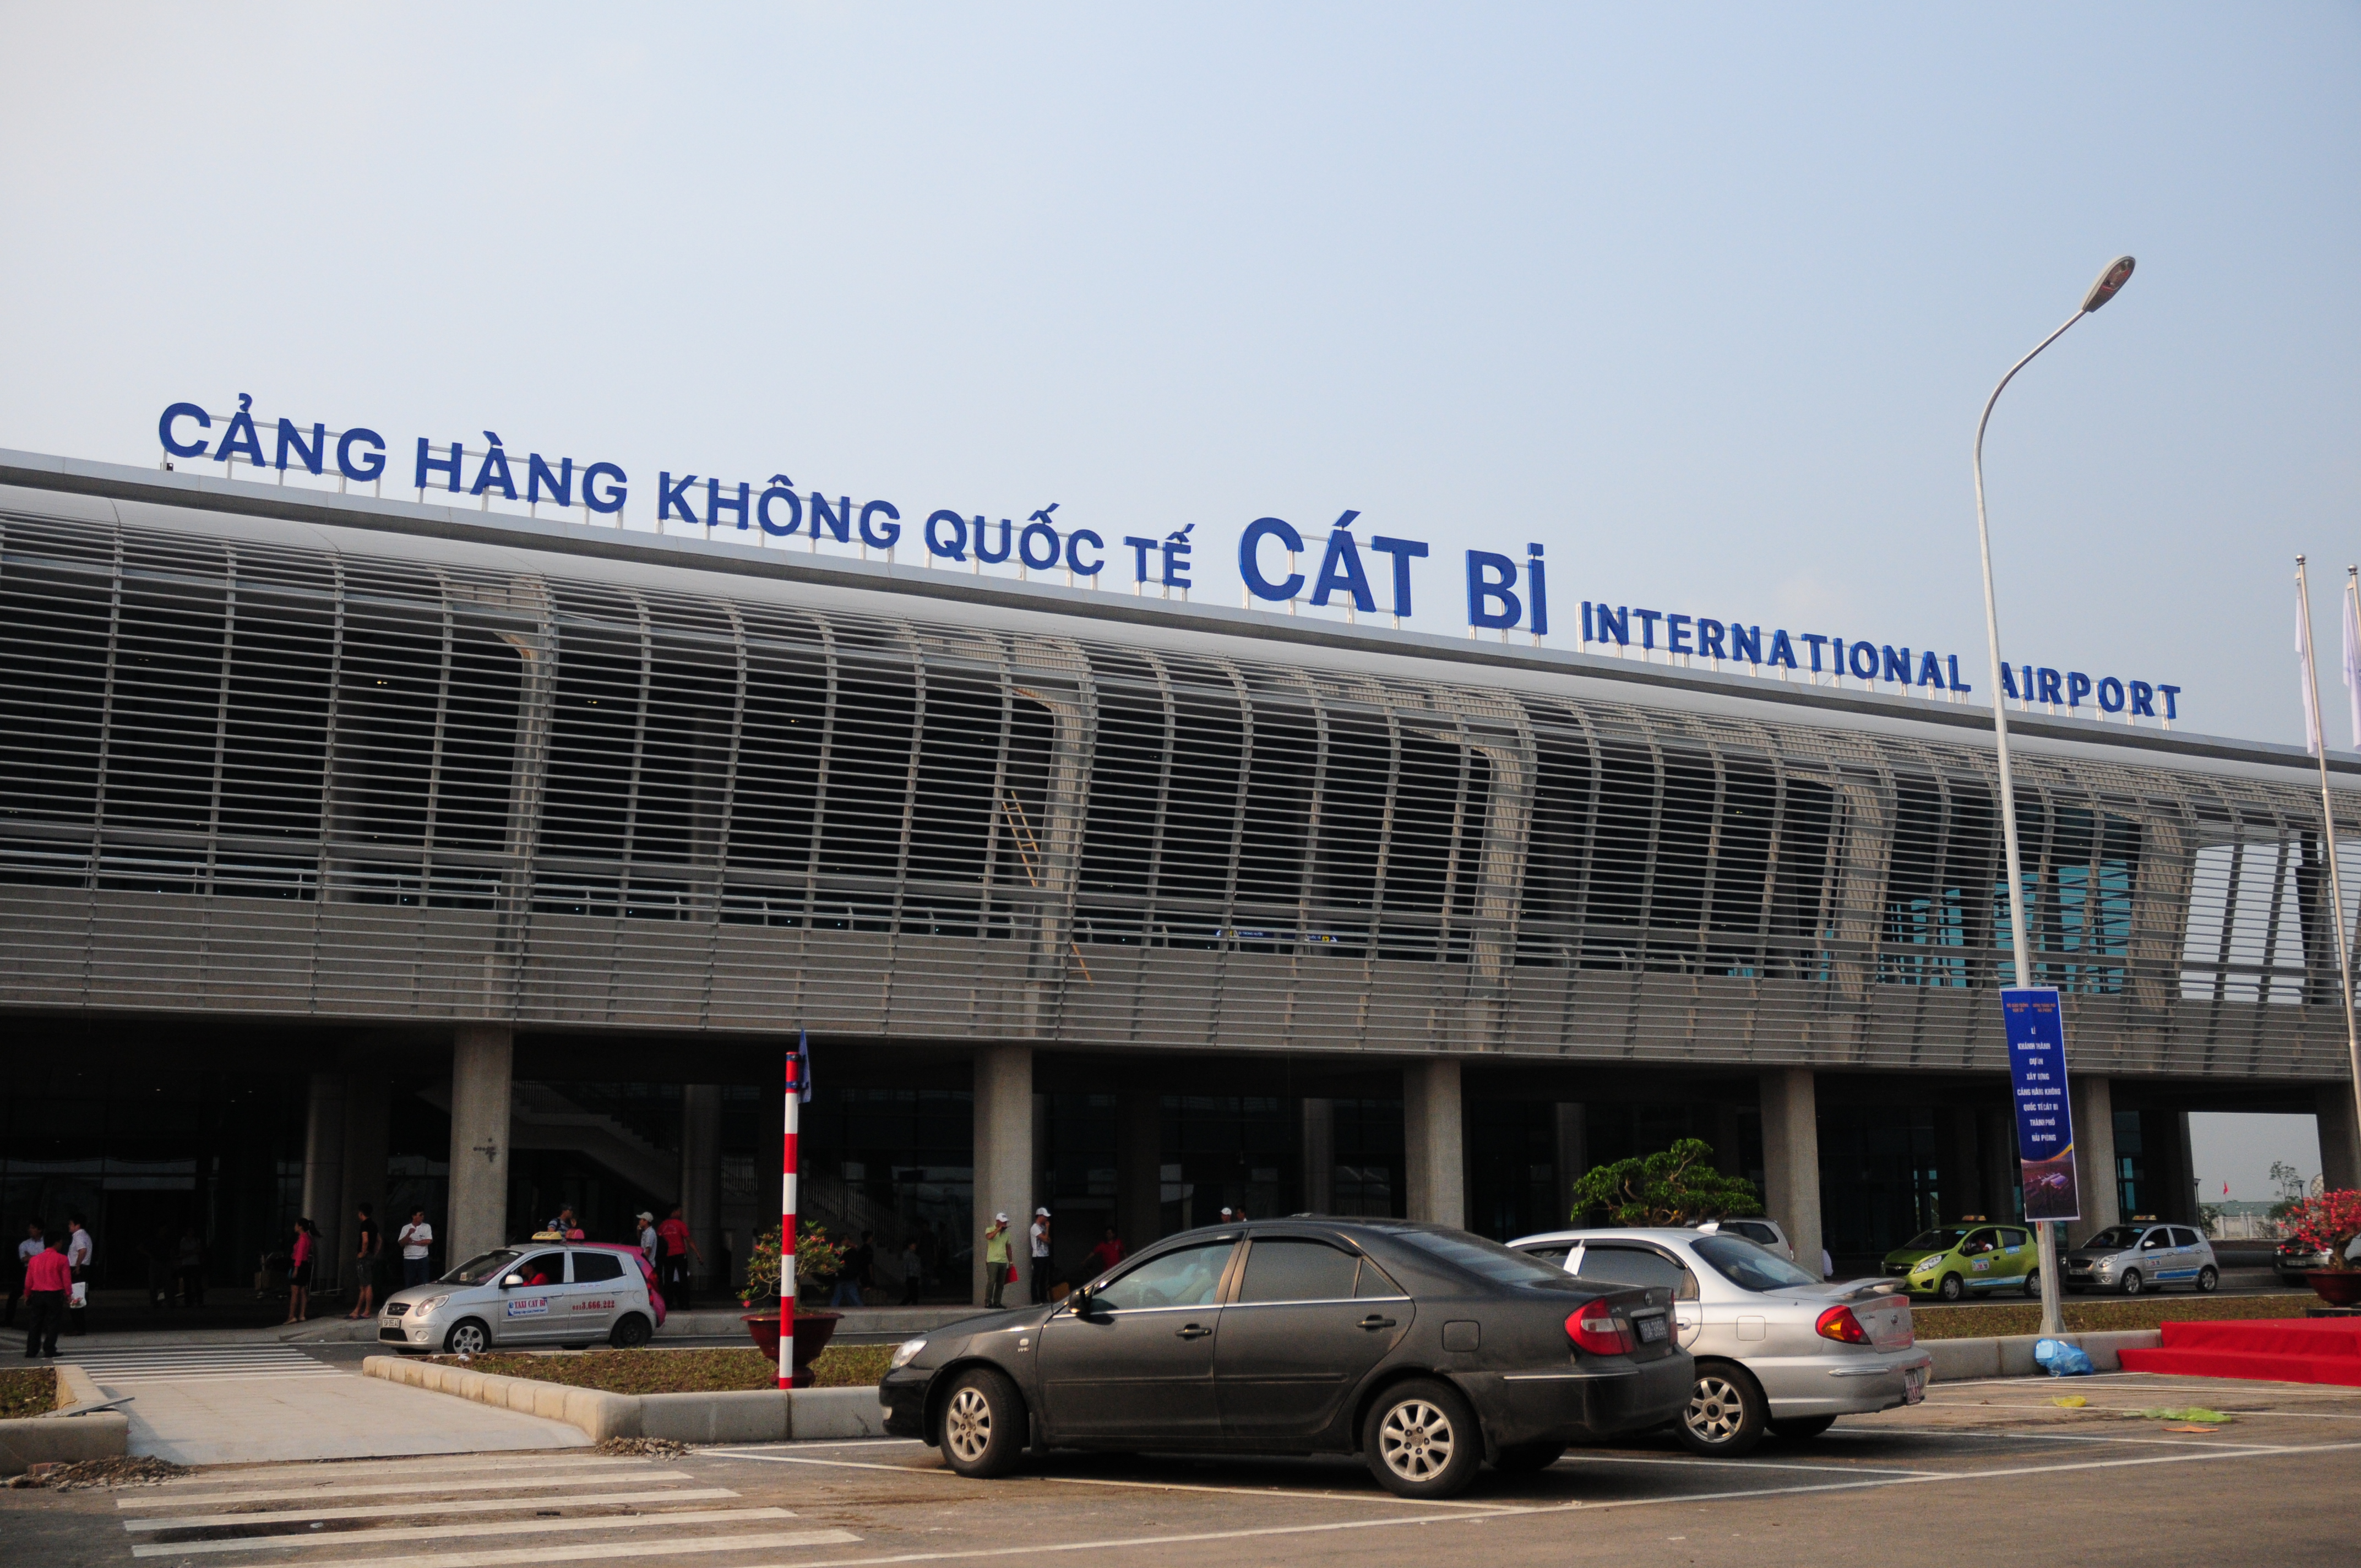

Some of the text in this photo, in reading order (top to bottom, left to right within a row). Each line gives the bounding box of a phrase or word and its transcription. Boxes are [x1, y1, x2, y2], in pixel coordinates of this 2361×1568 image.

[159, 393, 1196, 589] CẢNG HÀNG KHÔNG QUỐC TẾ
[1238, 509, 1429, 617] CÁT
[1581, 601, 2181, 720] INTERNATIONAL AIRPORT
